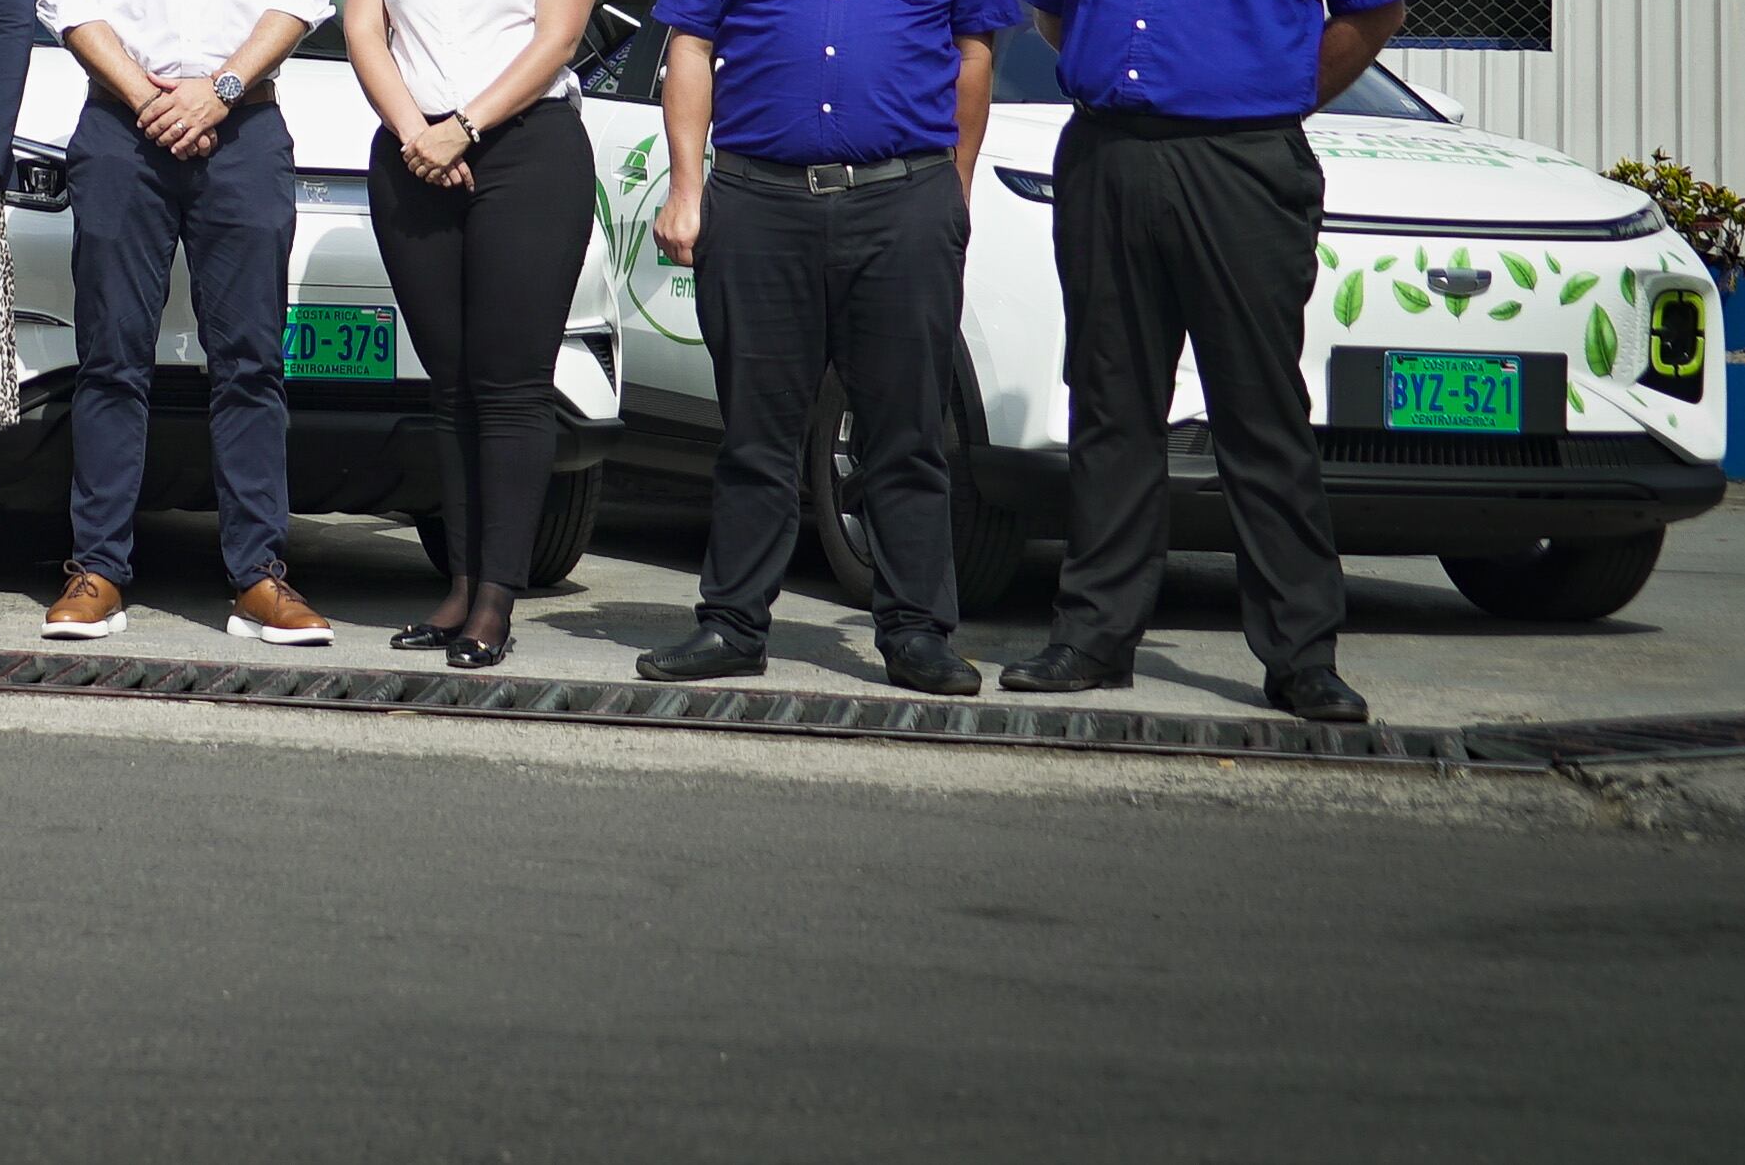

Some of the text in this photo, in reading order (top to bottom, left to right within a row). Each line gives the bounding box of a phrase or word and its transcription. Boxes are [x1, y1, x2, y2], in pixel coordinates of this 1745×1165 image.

[295, 309, 358, 321] COSTA RICA
[283, 323, 389, 362] ZD-379
[283, 363, 370, 375] CENTROAMERICA
[1423, 360, 1457, 371] COSTA
[1460, 362, 1485, 372] RICA
[1393, 372, 1513, 414] BYZ-521
[1412, 414, 1497, 427] CENTROAMERICA
